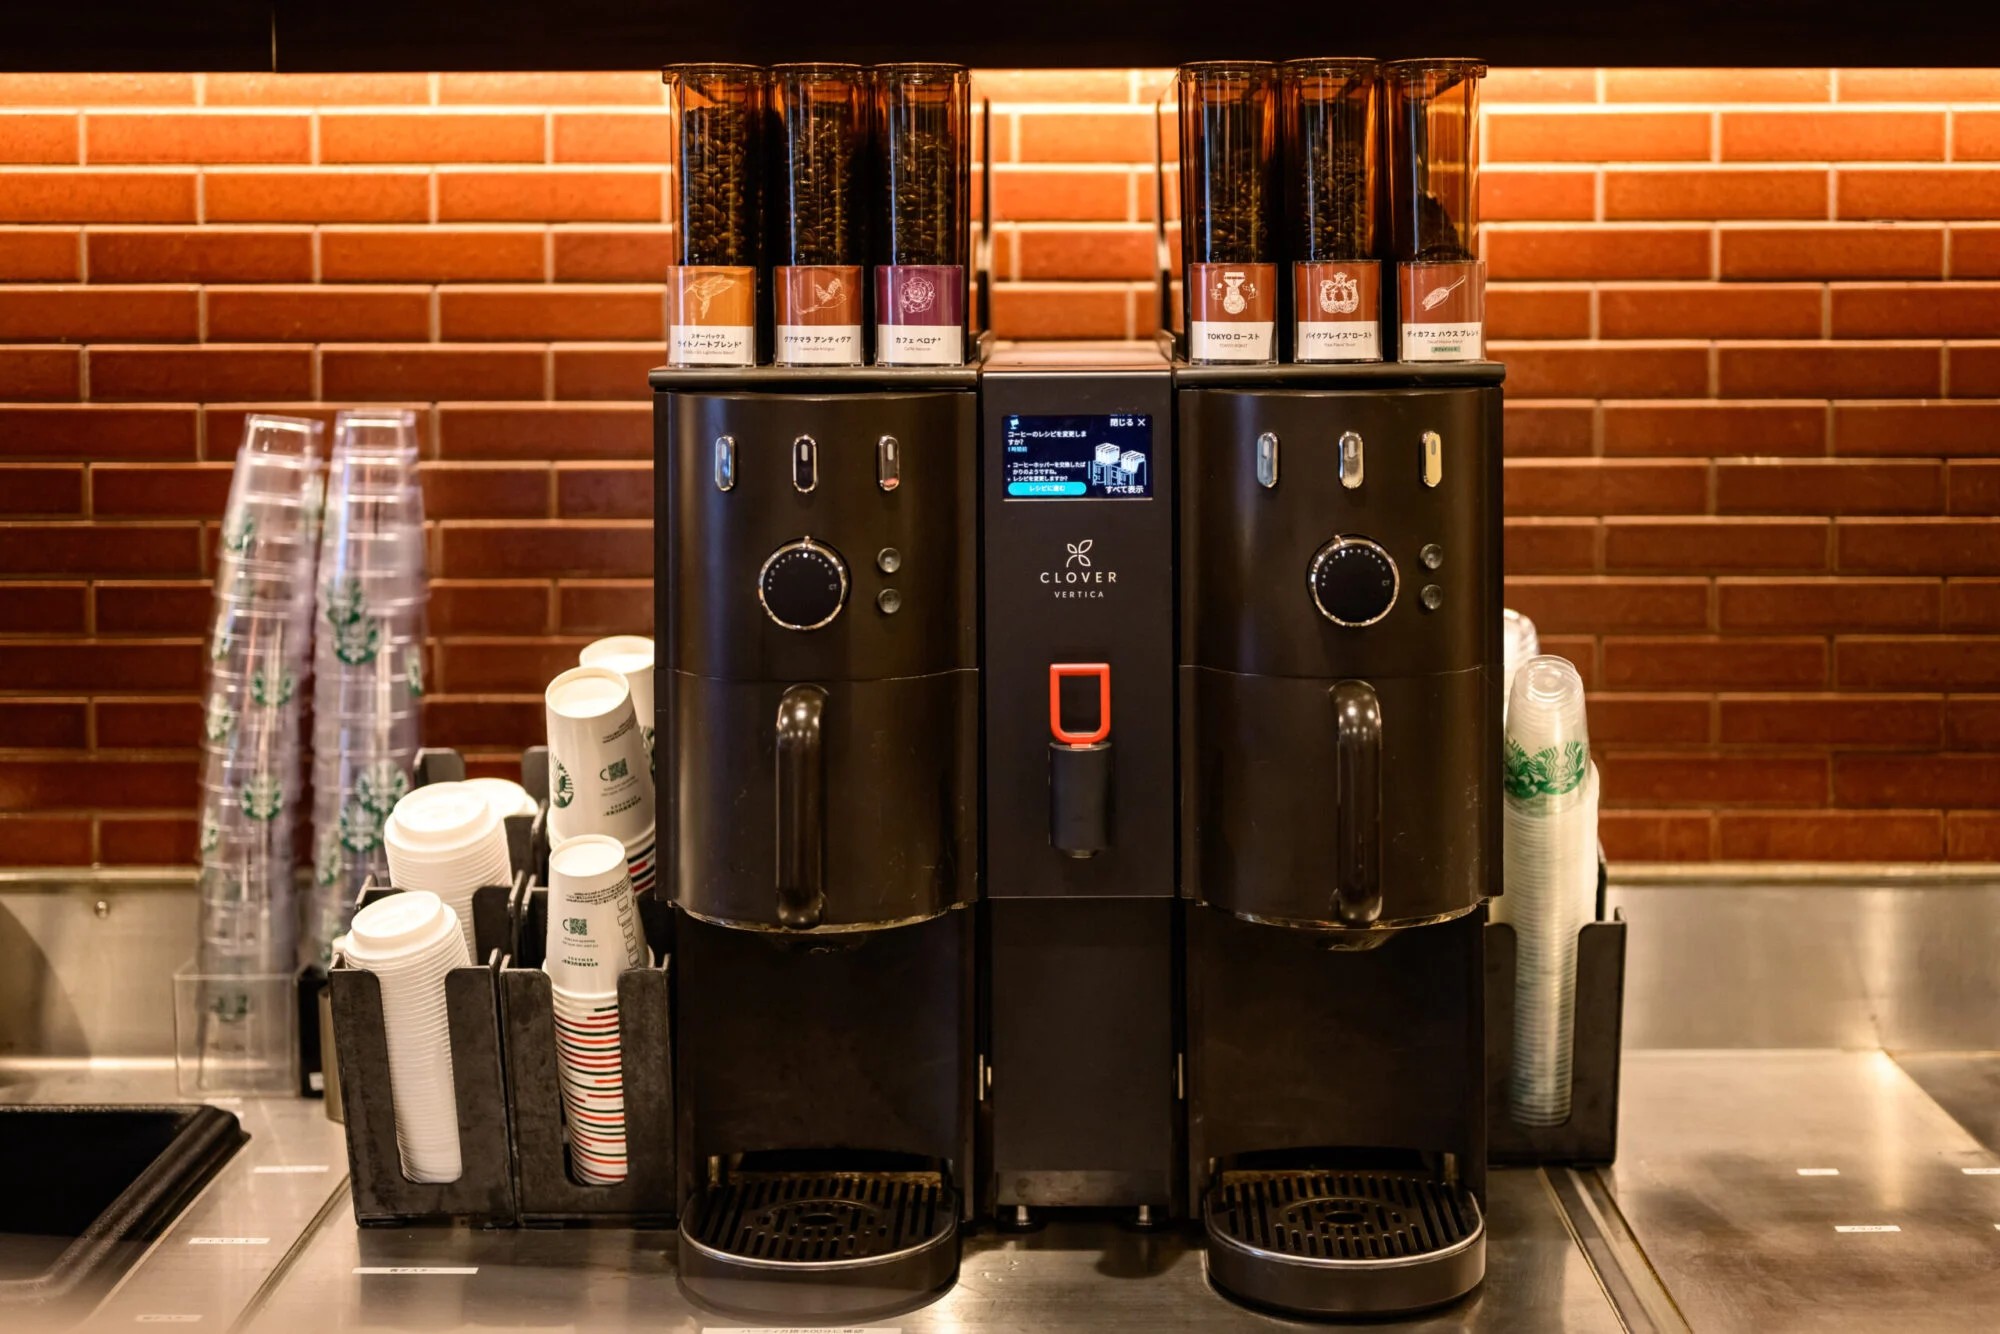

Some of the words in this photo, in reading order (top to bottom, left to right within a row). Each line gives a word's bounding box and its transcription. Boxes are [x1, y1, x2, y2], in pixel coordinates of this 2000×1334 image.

[814, 336, 852, 344] アンティグア
[895, 336, 914, 344] カフェ
[1207, 333, 1232, 341] TOKYO
[1233, 333, 1260, 341] ロースト
[1109, 418, 1134, 427] 閉じる
[1007, 430, 1087, 438] コーヒーのレシピを変更しま
[1105, 485, 1145, 494] すべて表示
[1040, 572, 1117, 584] CLOVER
